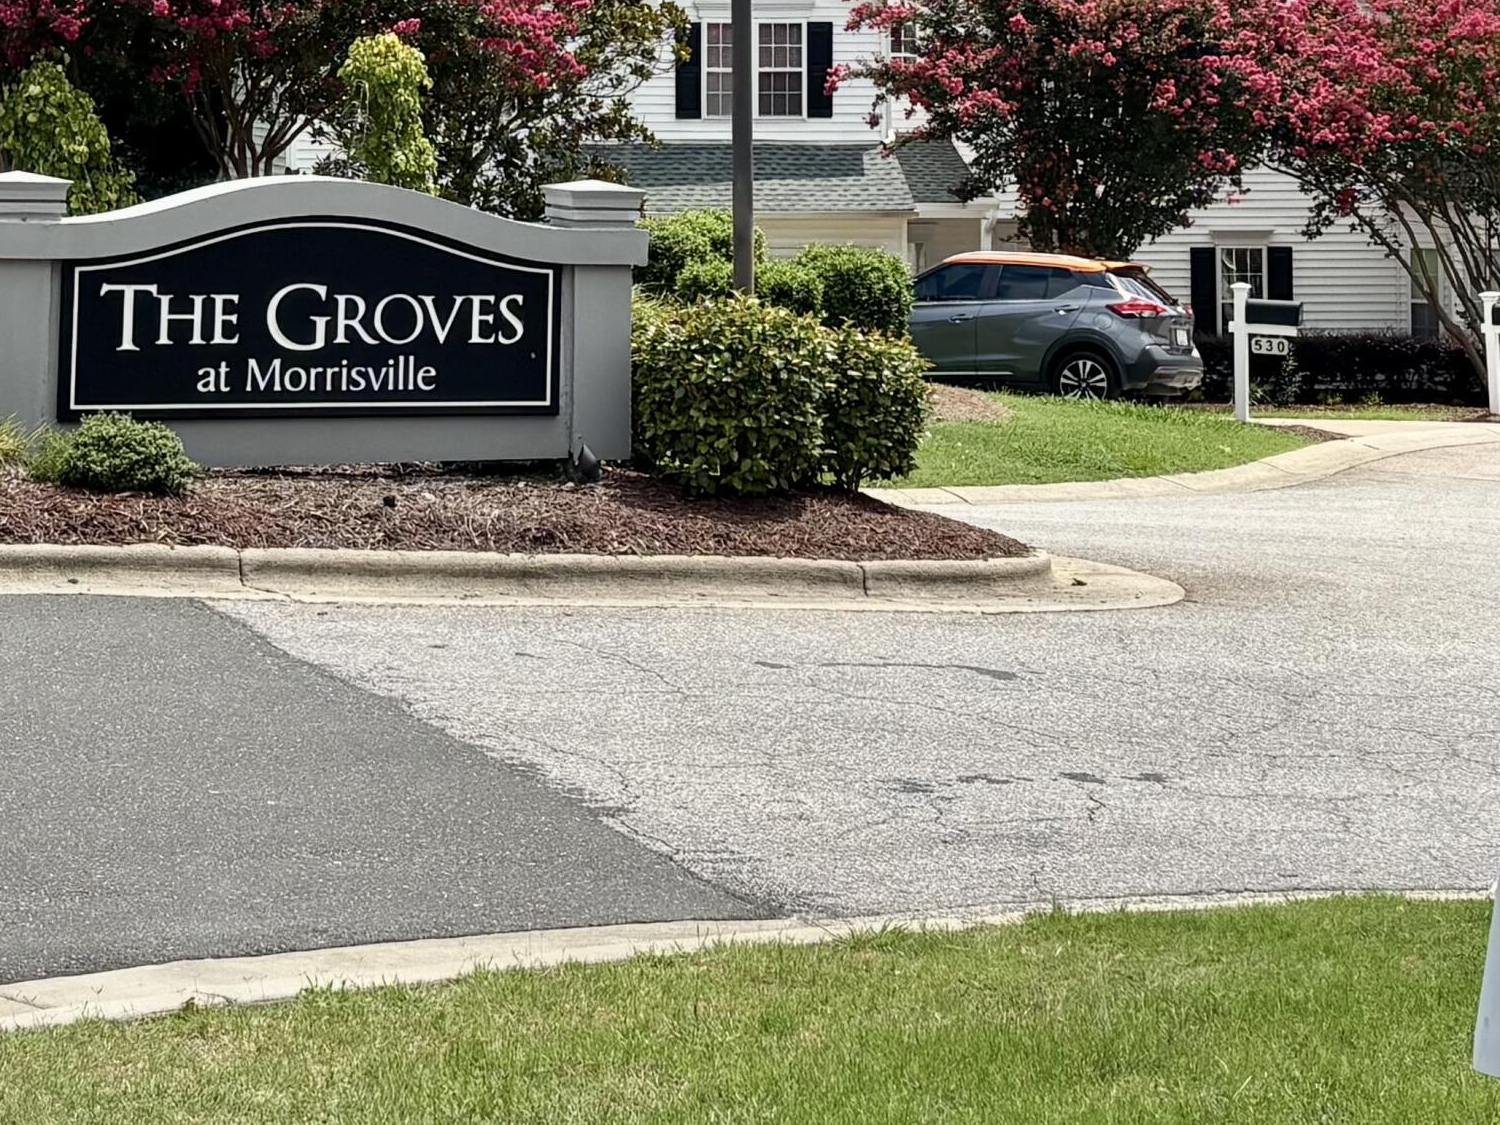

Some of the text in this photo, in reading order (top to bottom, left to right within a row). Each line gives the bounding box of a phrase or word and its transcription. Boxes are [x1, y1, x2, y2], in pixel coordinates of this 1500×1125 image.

[100, 282, 525, 352] THE GROVES
[1254, 339, 1285, 353] 530
[196, 355, 438, 393] at Morrisville
